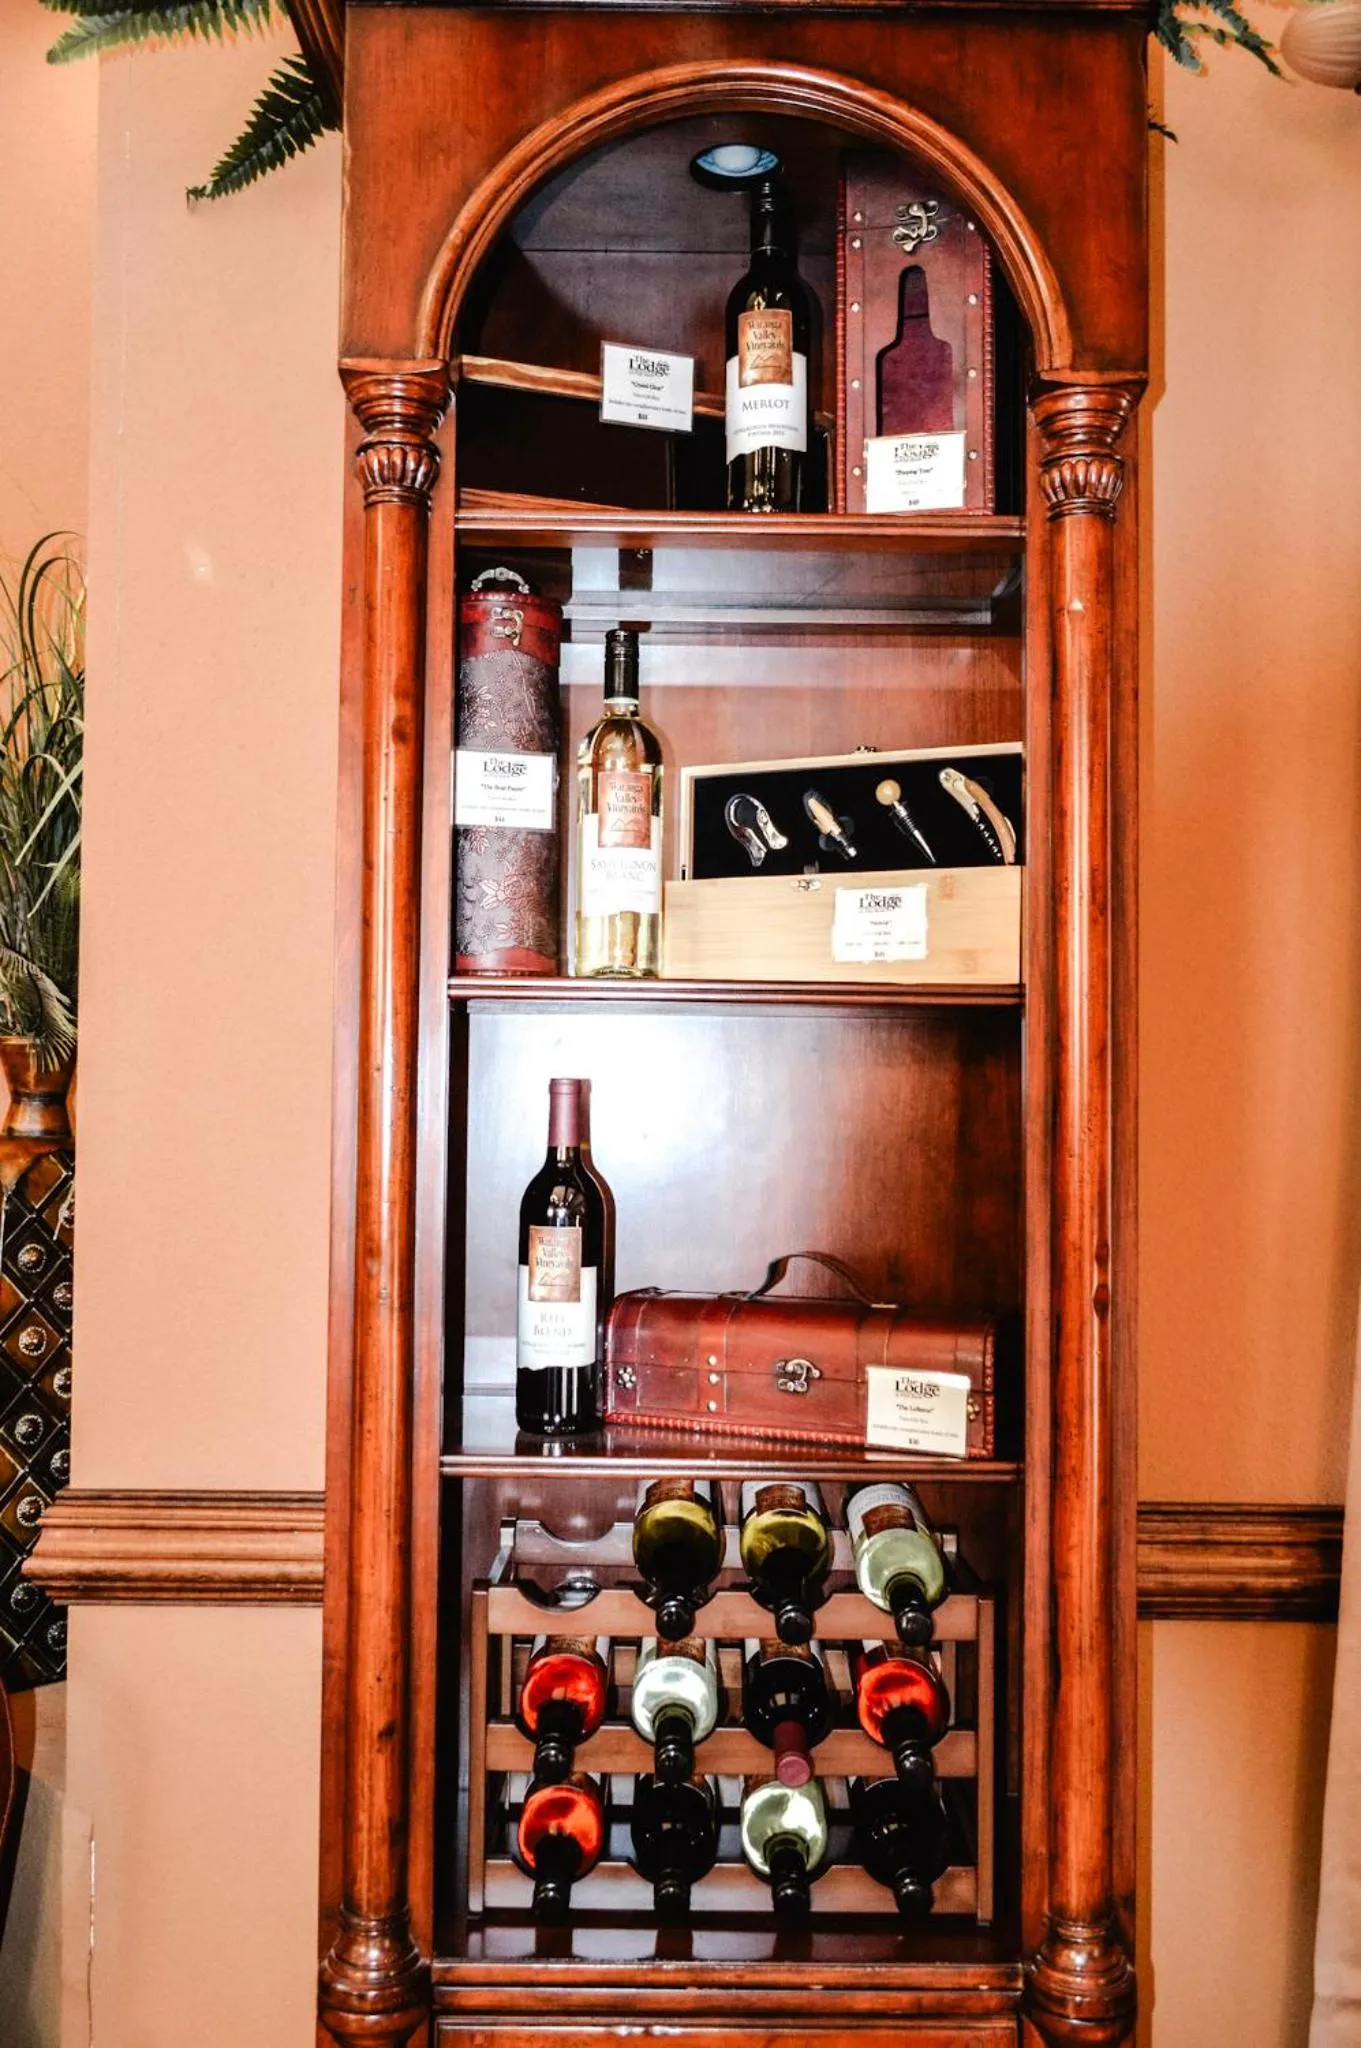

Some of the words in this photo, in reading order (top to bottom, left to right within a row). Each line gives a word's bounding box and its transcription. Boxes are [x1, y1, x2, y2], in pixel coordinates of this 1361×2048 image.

[753, 330, 777, 341] Valley
[746, 340, 785, 351] Vineyards
[634, 355, 650, 364] The
[629, 358, 670, 377] Lodge
[743, 399, 790, 412] MERLOT
[894, 445, 939, 460] Lodge
[489, 757, 504, 765] The
[483, 761, 528, 777] Lodge
[614, 792, 638, 803] Valley
[607, 802, 646, 815] Vineyards
[865, 892, 880, 900] The
[859, 895, 902, 911] Lodge
[901, 1376, 917, 1384] The
[895, 1380, 940, 1398] Lodge
